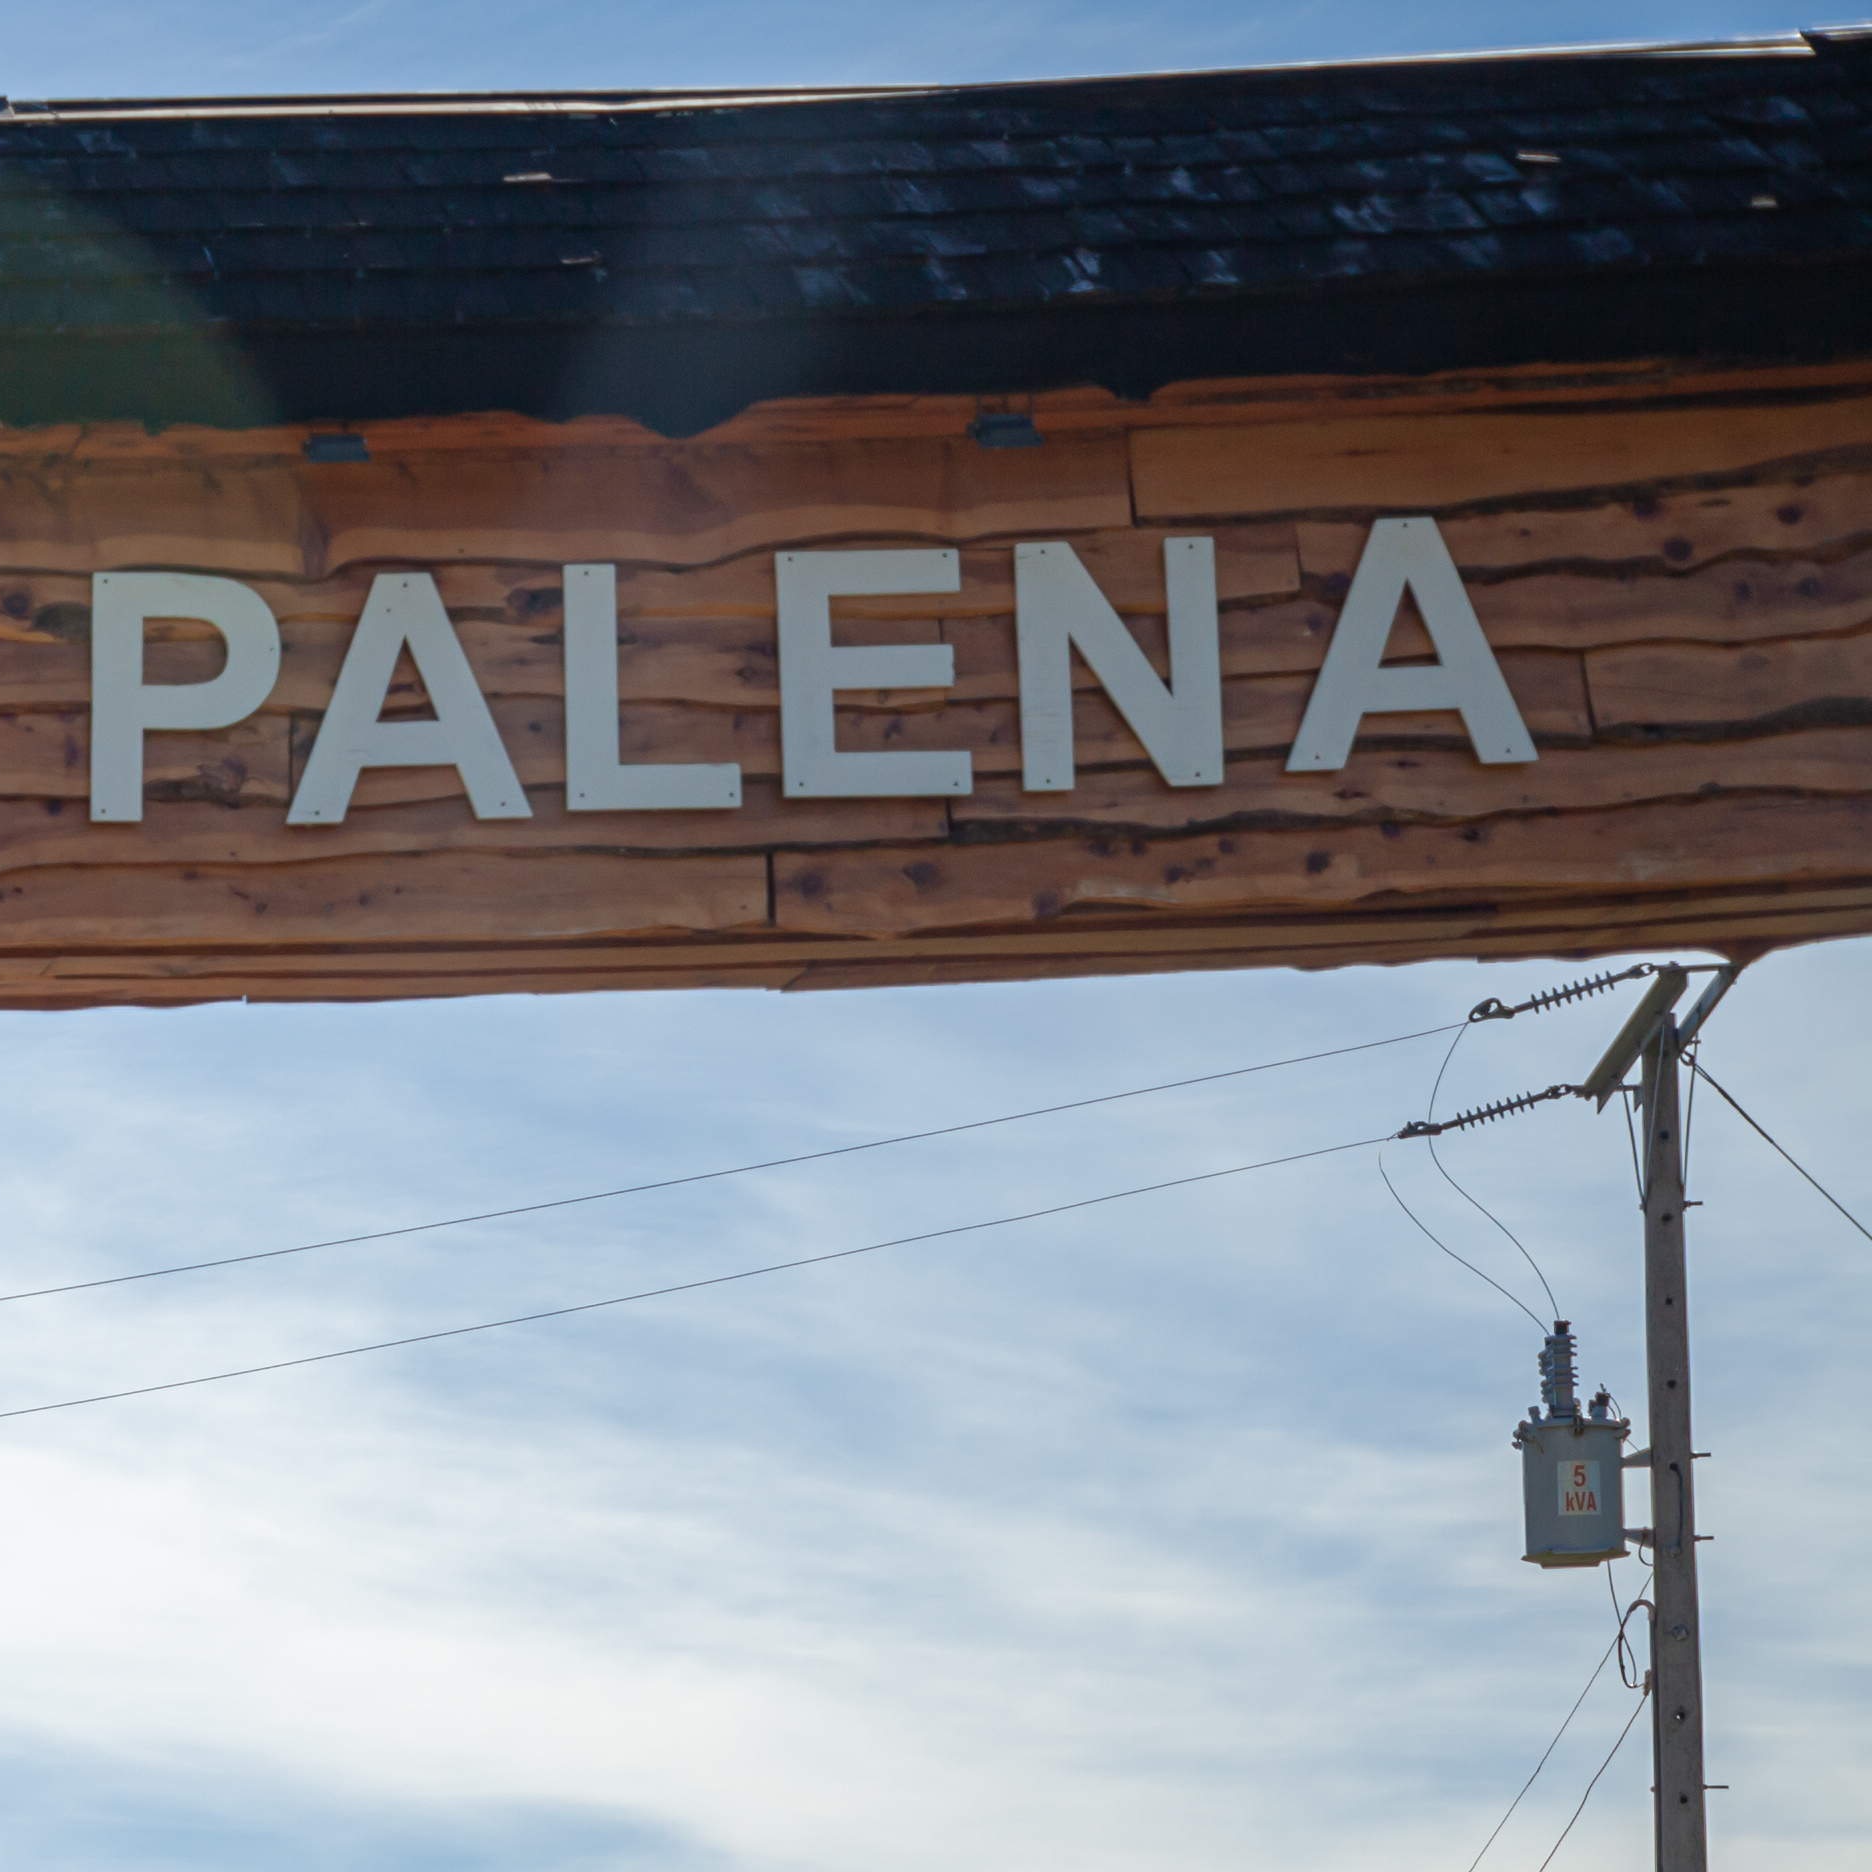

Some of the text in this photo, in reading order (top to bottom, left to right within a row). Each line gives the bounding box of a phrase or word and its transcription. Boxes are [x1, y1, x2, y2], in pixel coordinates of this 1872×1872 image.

[89, 515, 1540, 826] PALENA
[1574, 1464, 1586, 1488] 5
[1565, 1491, 1597, 1512] kVA
